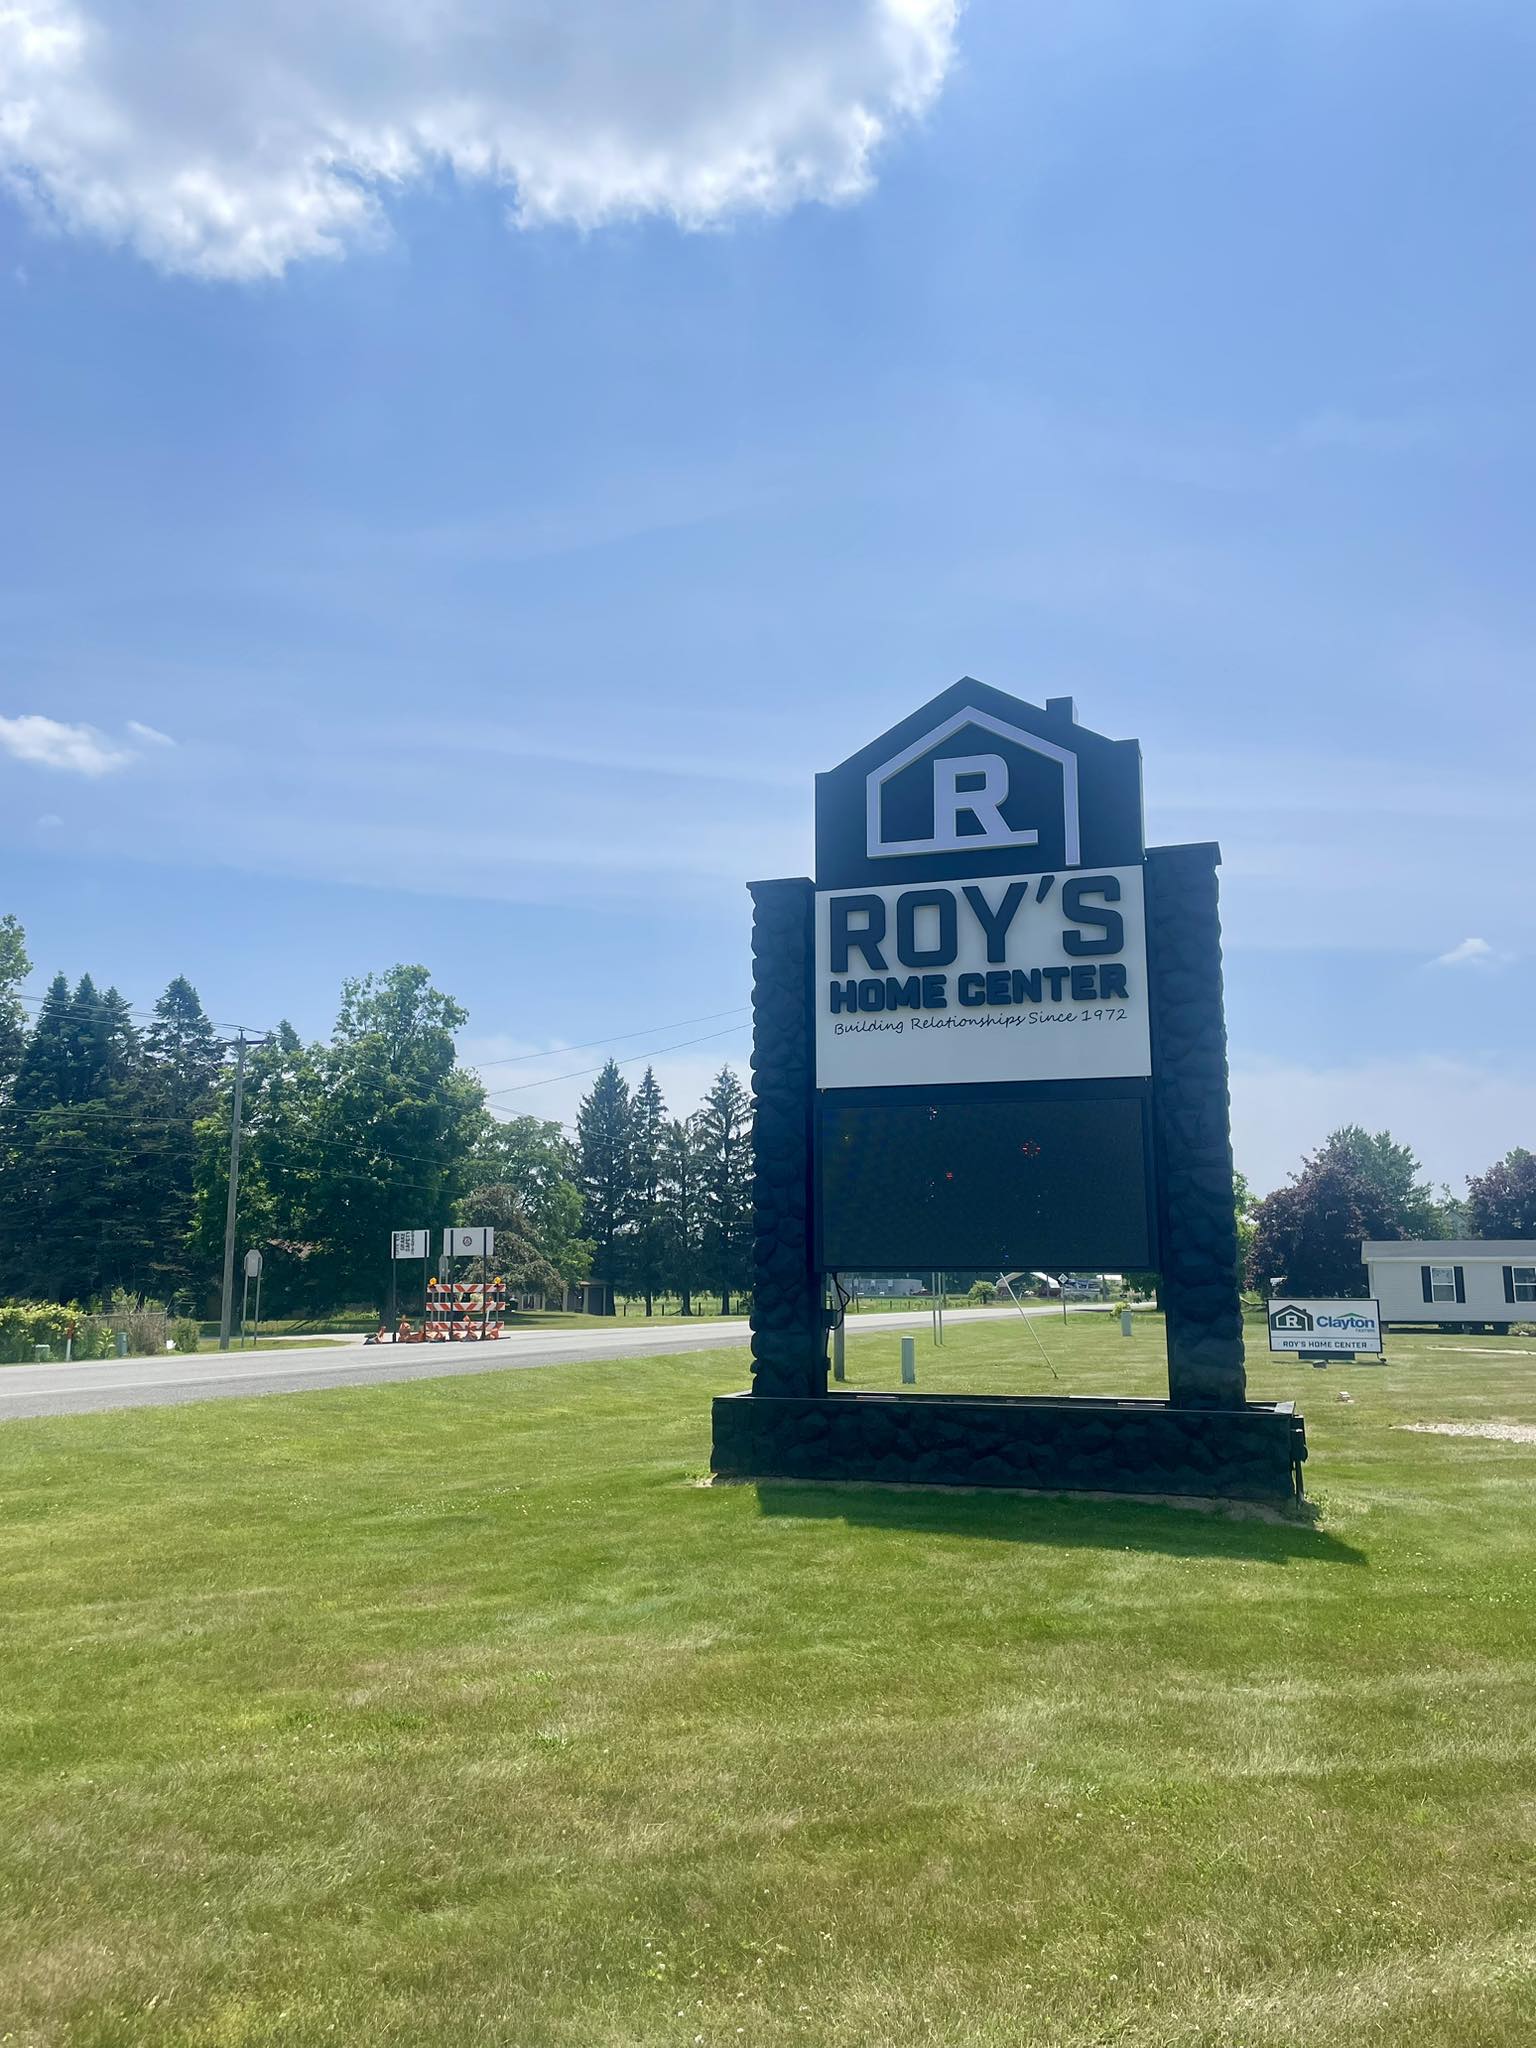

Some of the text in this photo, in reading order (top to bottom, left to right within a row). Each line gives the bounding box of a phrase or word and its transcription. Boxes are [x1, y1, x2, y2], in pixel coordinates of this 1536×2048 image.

[933, 753, 1030, 845] R
[829, 875, 1125, 973] ROY'S
[830, 963, 1129, 1014] HOME CENTER
[834, 1008, 1128, 1035] Building Relationships Since 1972
[1285, 1315, 1299, 1328] R
[1316, 1315, 1375, 1330] Clayton
[1334, 1341, 1367, 1349] CENTER
